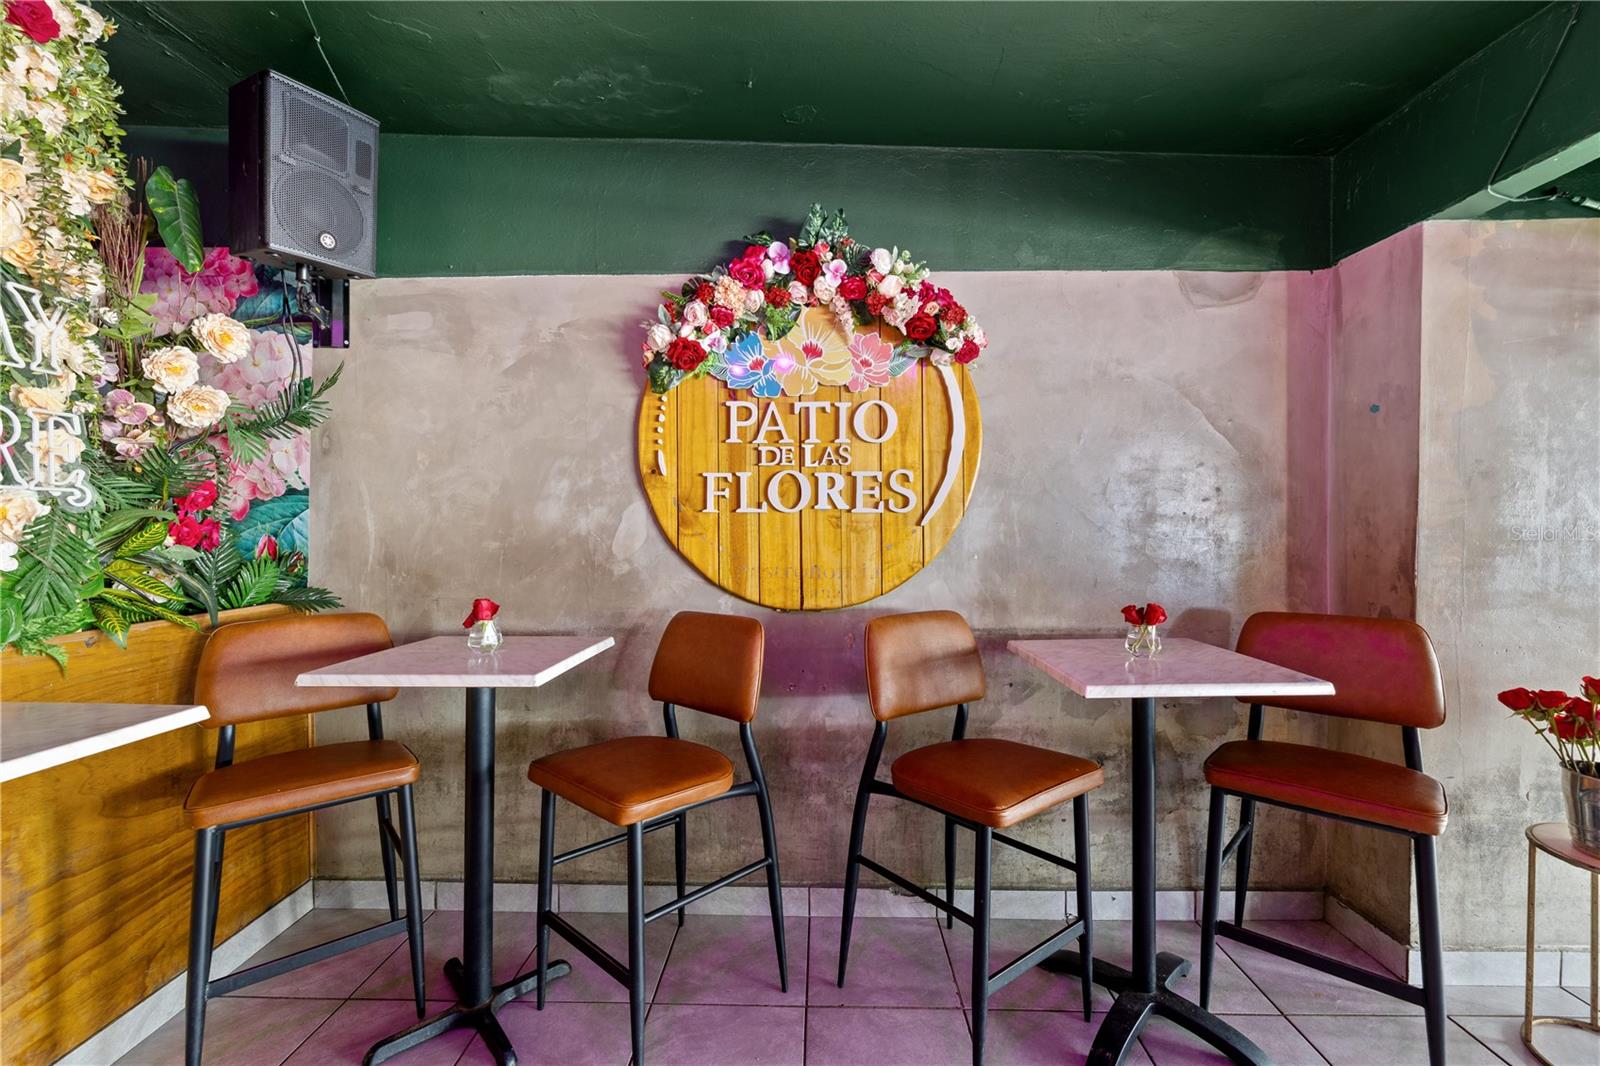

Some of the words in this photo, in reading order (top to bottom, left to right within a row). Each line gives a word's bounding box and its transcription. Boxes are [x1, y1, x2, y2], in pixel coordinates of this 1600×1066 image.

[725, 399, 899, 443] PATIO
[758, 446, 795, 467] DE
[801, 444, 852, 467] LAS
[702, 469, 918, 513] FLORES
